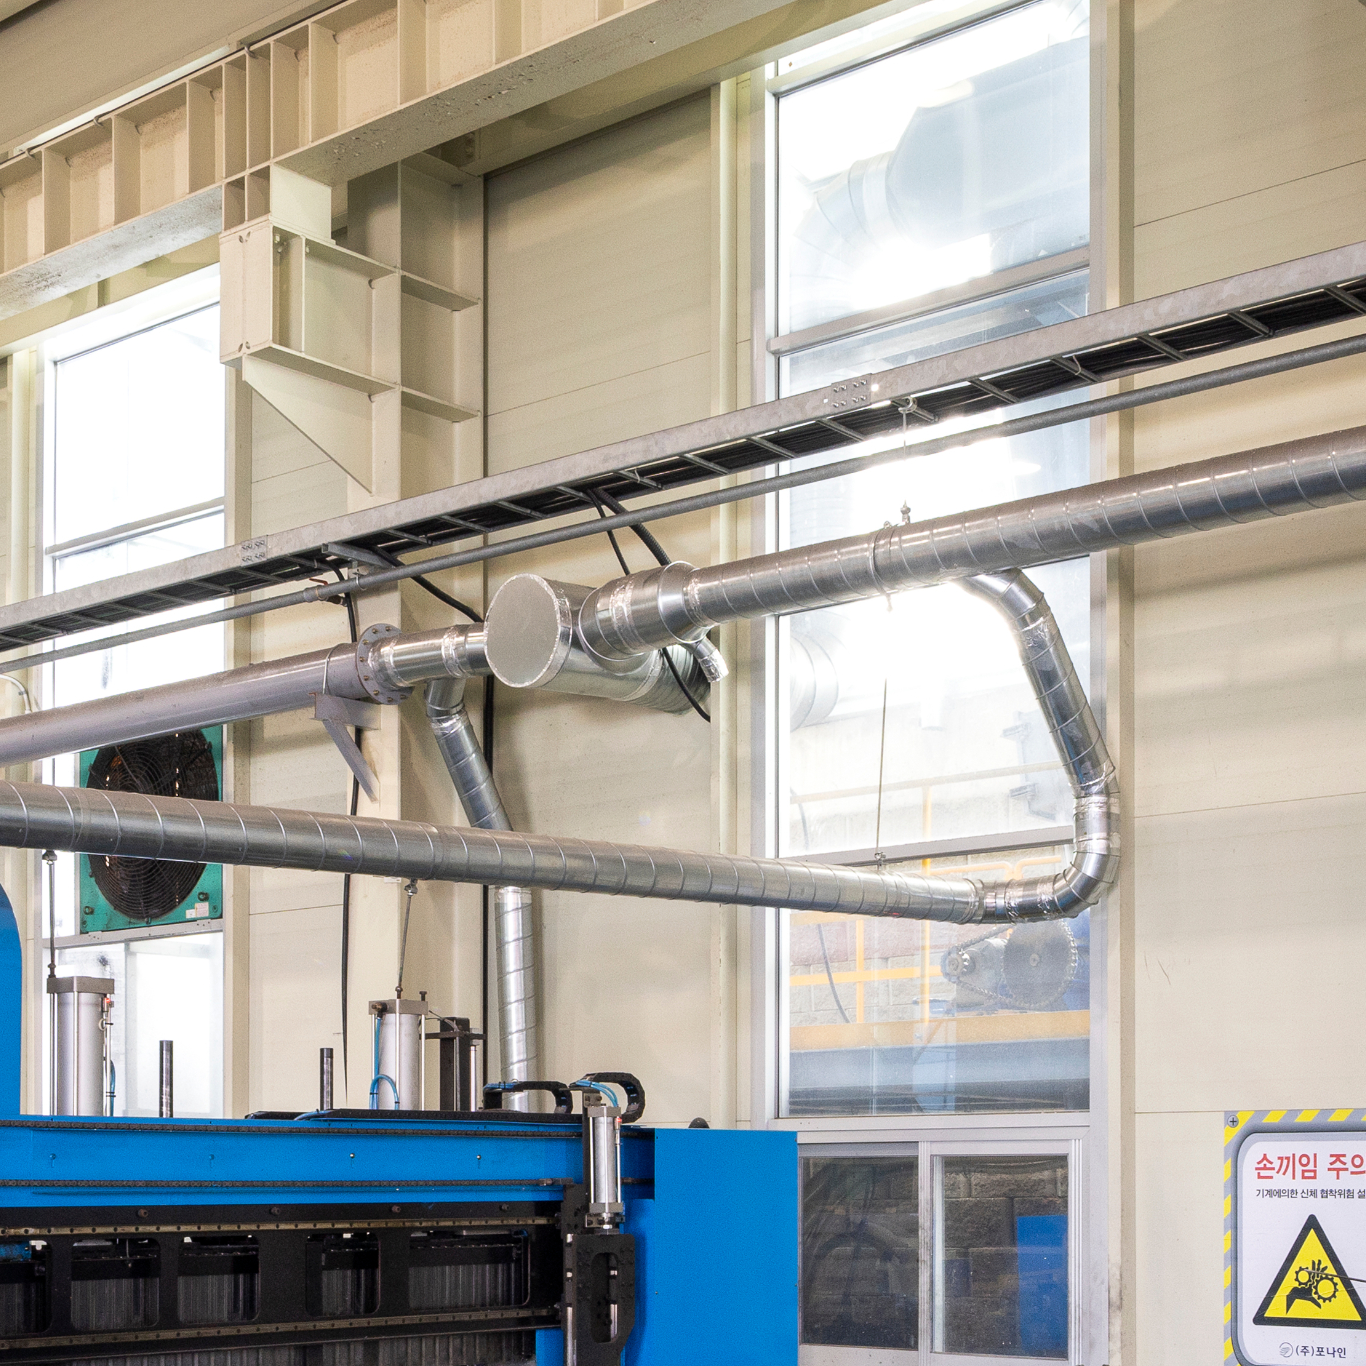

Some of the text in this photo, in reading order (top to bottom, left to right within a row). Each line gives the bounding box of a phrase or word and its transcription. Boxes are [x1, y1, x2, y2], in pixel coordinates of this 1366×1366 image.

[1255, 1152, 1318, 1180] 손끼임
[1256, 1188, 1298, 1199] 기계에의한
[1300, 1188, 1317, 1199] 신체
[1320, 1188, 1355, 1199] 협착위험
[1295, 1345, 1346, 1358] (주)포나인
